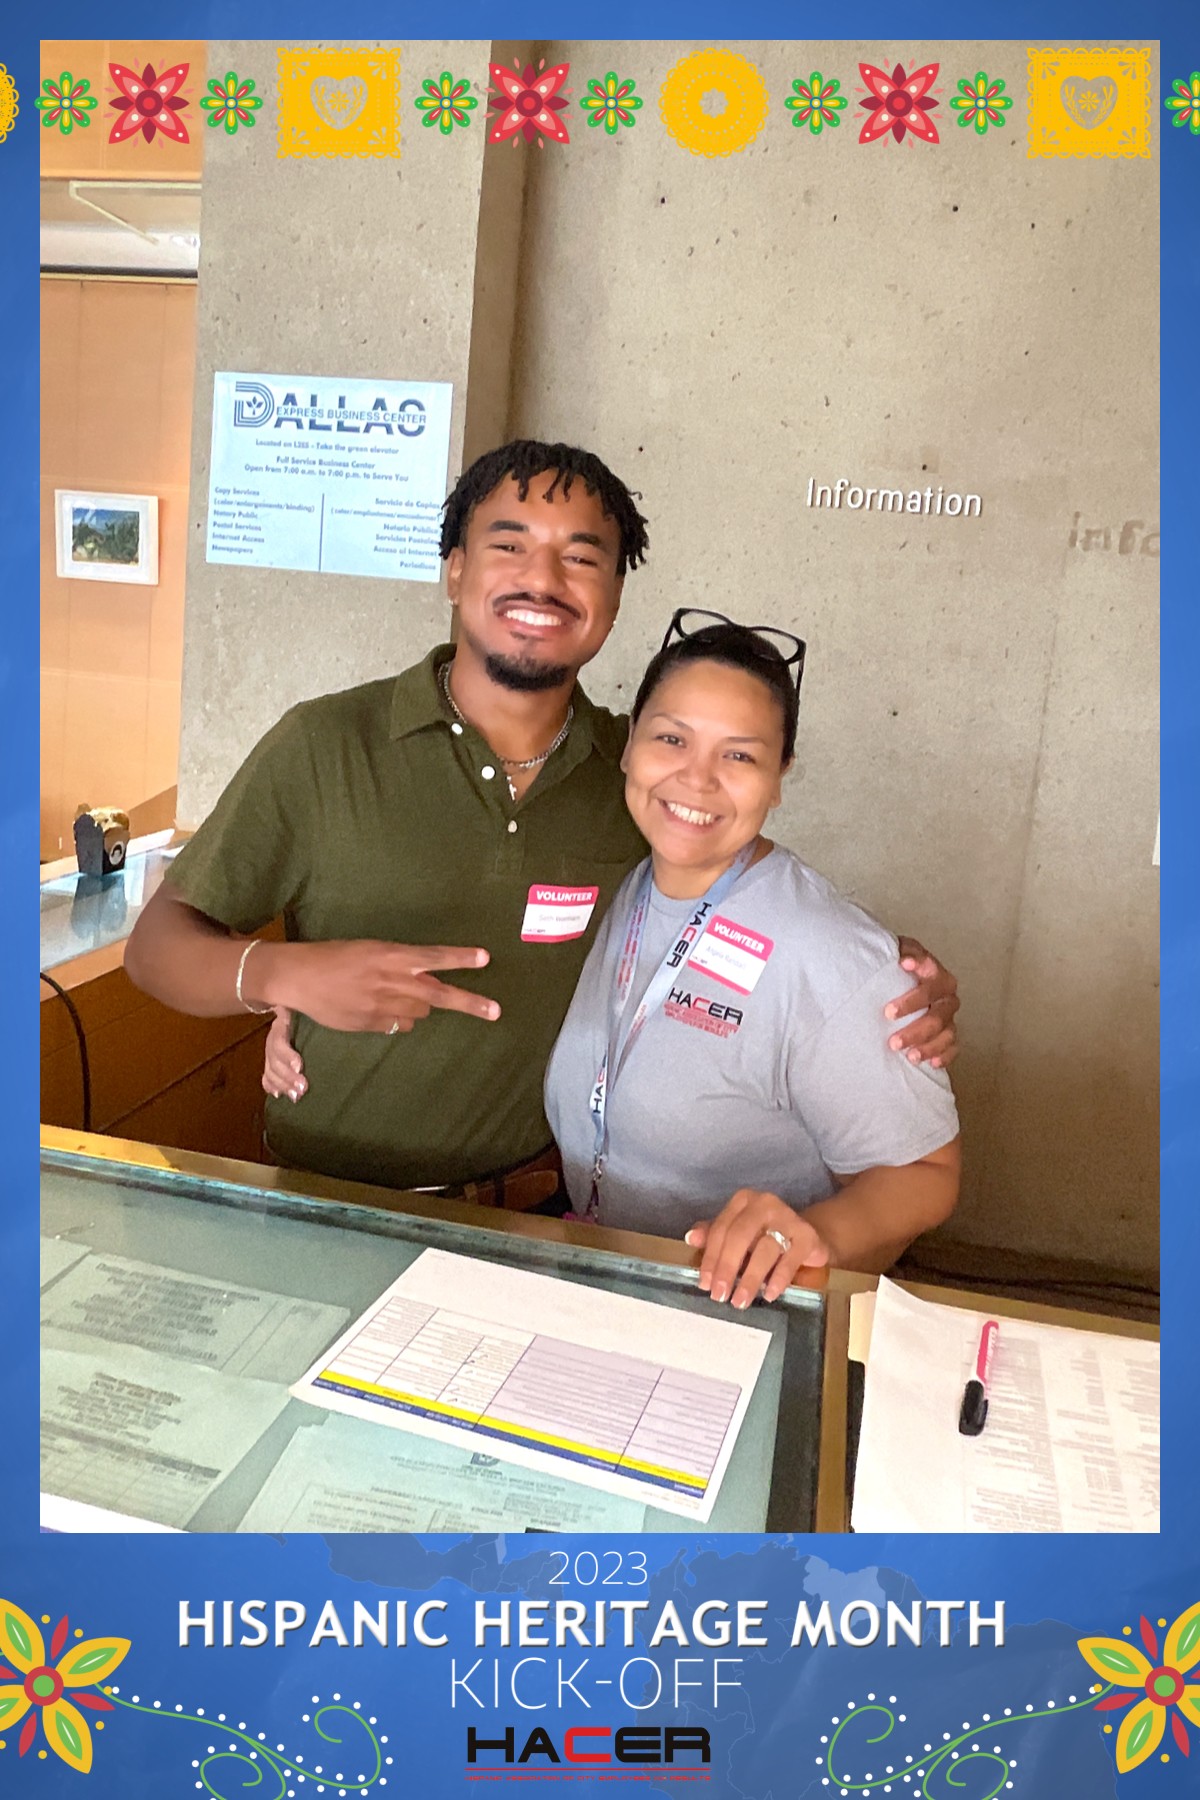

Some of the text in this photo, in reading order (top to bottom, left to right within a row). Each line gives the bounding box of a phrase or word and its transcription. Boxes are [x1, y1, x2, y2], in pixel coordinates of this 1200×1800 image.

[276, 406, 426, 424] EXPRESS BUSINESS CENTER
[255, 439, 282, 447] Located
[316, 442, 333, 450] Take
[370, 445, 399, 455] elevator
[276, 456, 376, 470] Full Service Business Center
[244, 463, 263, 473] Open
[265, 465, 281, 473] from
[284, 466, 299, 474] 7:00
[318, 468, 326, 476] to
[328, 469, 344, 477] 7:00
[363, 472, 371, 480] to
[373, 472, 393, 481] Serve
[395, 473, 409, 482] You
[215, 486, 260, 496] Copy Services
[806, 477, 982, 517] Information
[375, 497, 403, 507] Servicio
[405, 499, 414, 507] de
[213, 510, 258, 519] Notary Public
[213, 521, 262, 532] Postal Services
[384, 523, 411, 532] Notario
[212, 532, 265, 543] Internet Access
[376, 533, 406, 543] Servicios
[212, 544, 253, 554] Newspapers
[536, 890, 593, 902] VOLUNTEER
[666, 901, 713, 968] HACER
[714, 922, 766, 954] VOLUNTEER
[668, 987, 744, 1026] HACER
